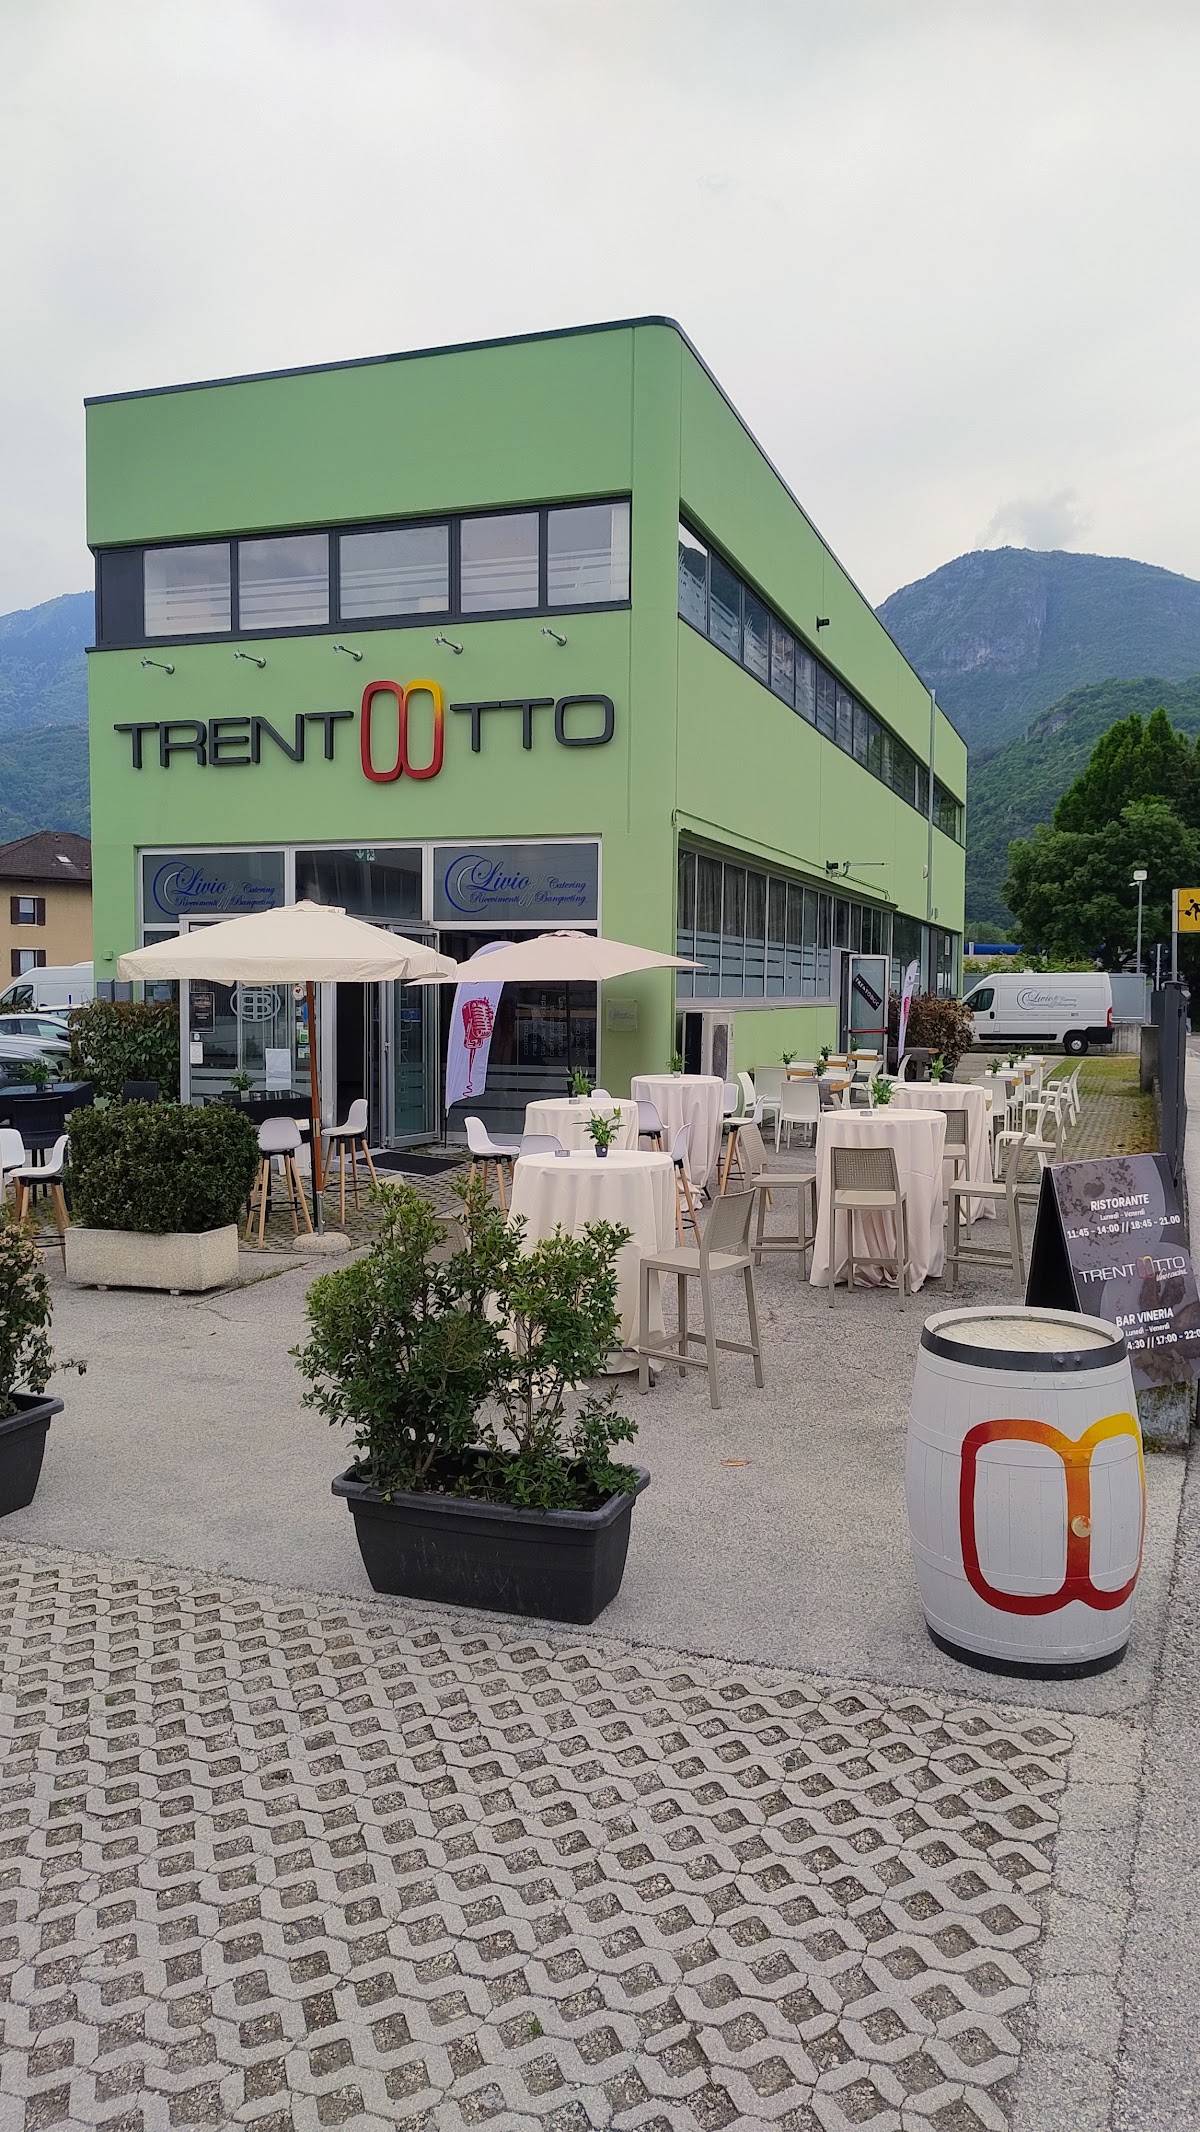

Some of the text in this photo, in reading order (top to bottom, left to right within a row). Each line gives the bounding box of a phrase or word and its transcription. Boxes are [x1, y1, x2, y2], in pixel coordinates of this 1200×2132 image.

[172, 866, 227, 896] Livio
[466, 859, 530, 892] Livio
[547, 876, 587, 893] Catering
[241, 882, 276, 896] Catering
[470, 891, 587, 906] Ricevimenti Banqueting
[231, 895, 276, 909] Banqueting
[1090, 1194, 1150, 1212] RISTORANTE
[1067, 1227, 1090, 1239] 11:45
[1097, 1224, 1120, 1235] 14:00
[1130, 1219, 1153, 1230] 18:45
[1159, 1215, 1181, 1226] 21.00
[1116, 1307, 1174, 1327] BAR VINERIA
[1126, 1338, 1145, 1350] 4:30
[1156, 1333, 1178, 1345] 17:00
[1184, 1328, 1200, 1340] 22:0
